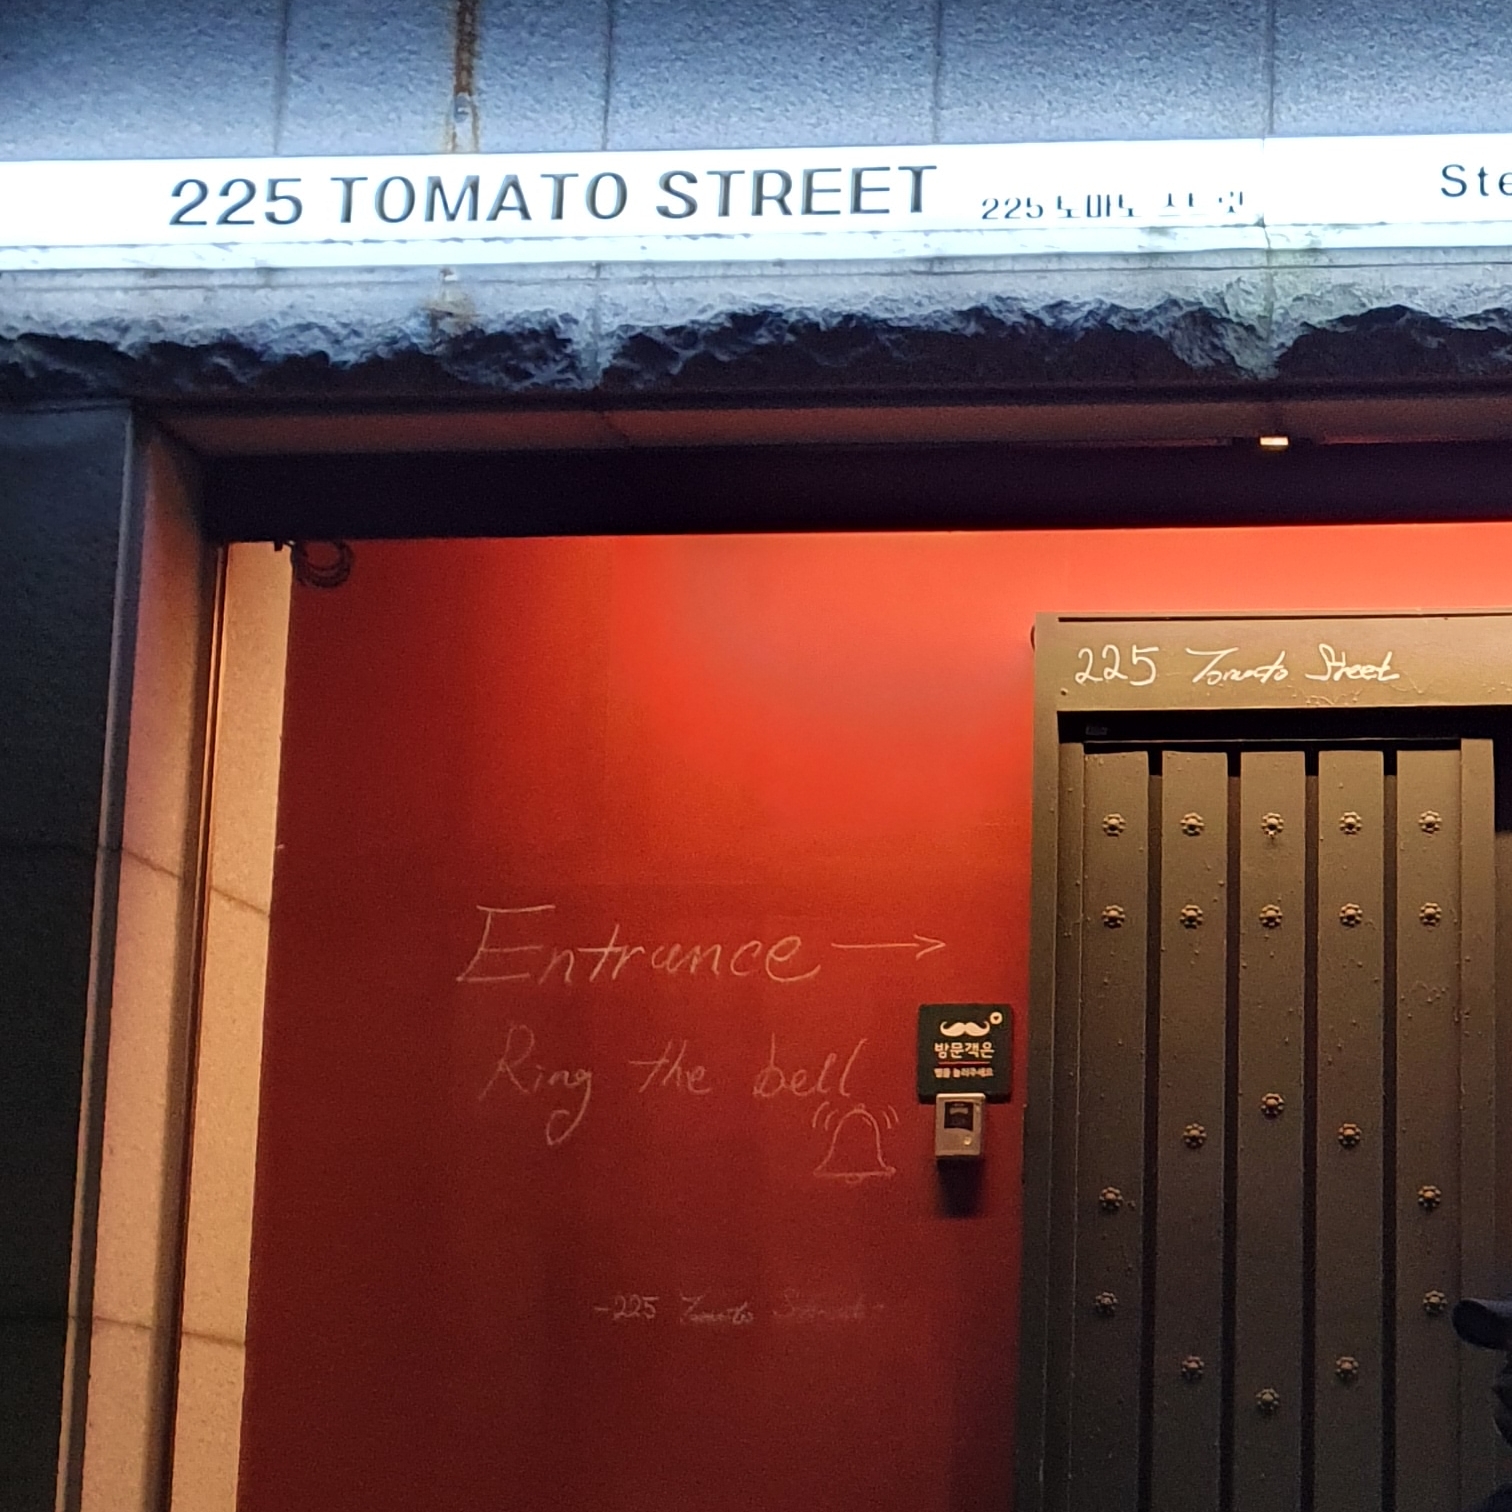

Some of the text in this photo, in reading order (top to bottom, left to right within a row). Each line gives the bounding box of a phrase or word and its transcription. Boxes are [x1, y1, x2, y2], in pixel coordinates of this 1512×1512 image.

[168, 164, 938, 227] 225 TOMATO STREET
[1074, 642, 1401, 687] 225 Tomato Street
[455, 903, 822, 984] Entrance
[933, 1040, 996, 1060] 방문객은
[476, 1023, 869, 1146] Ring the bell
